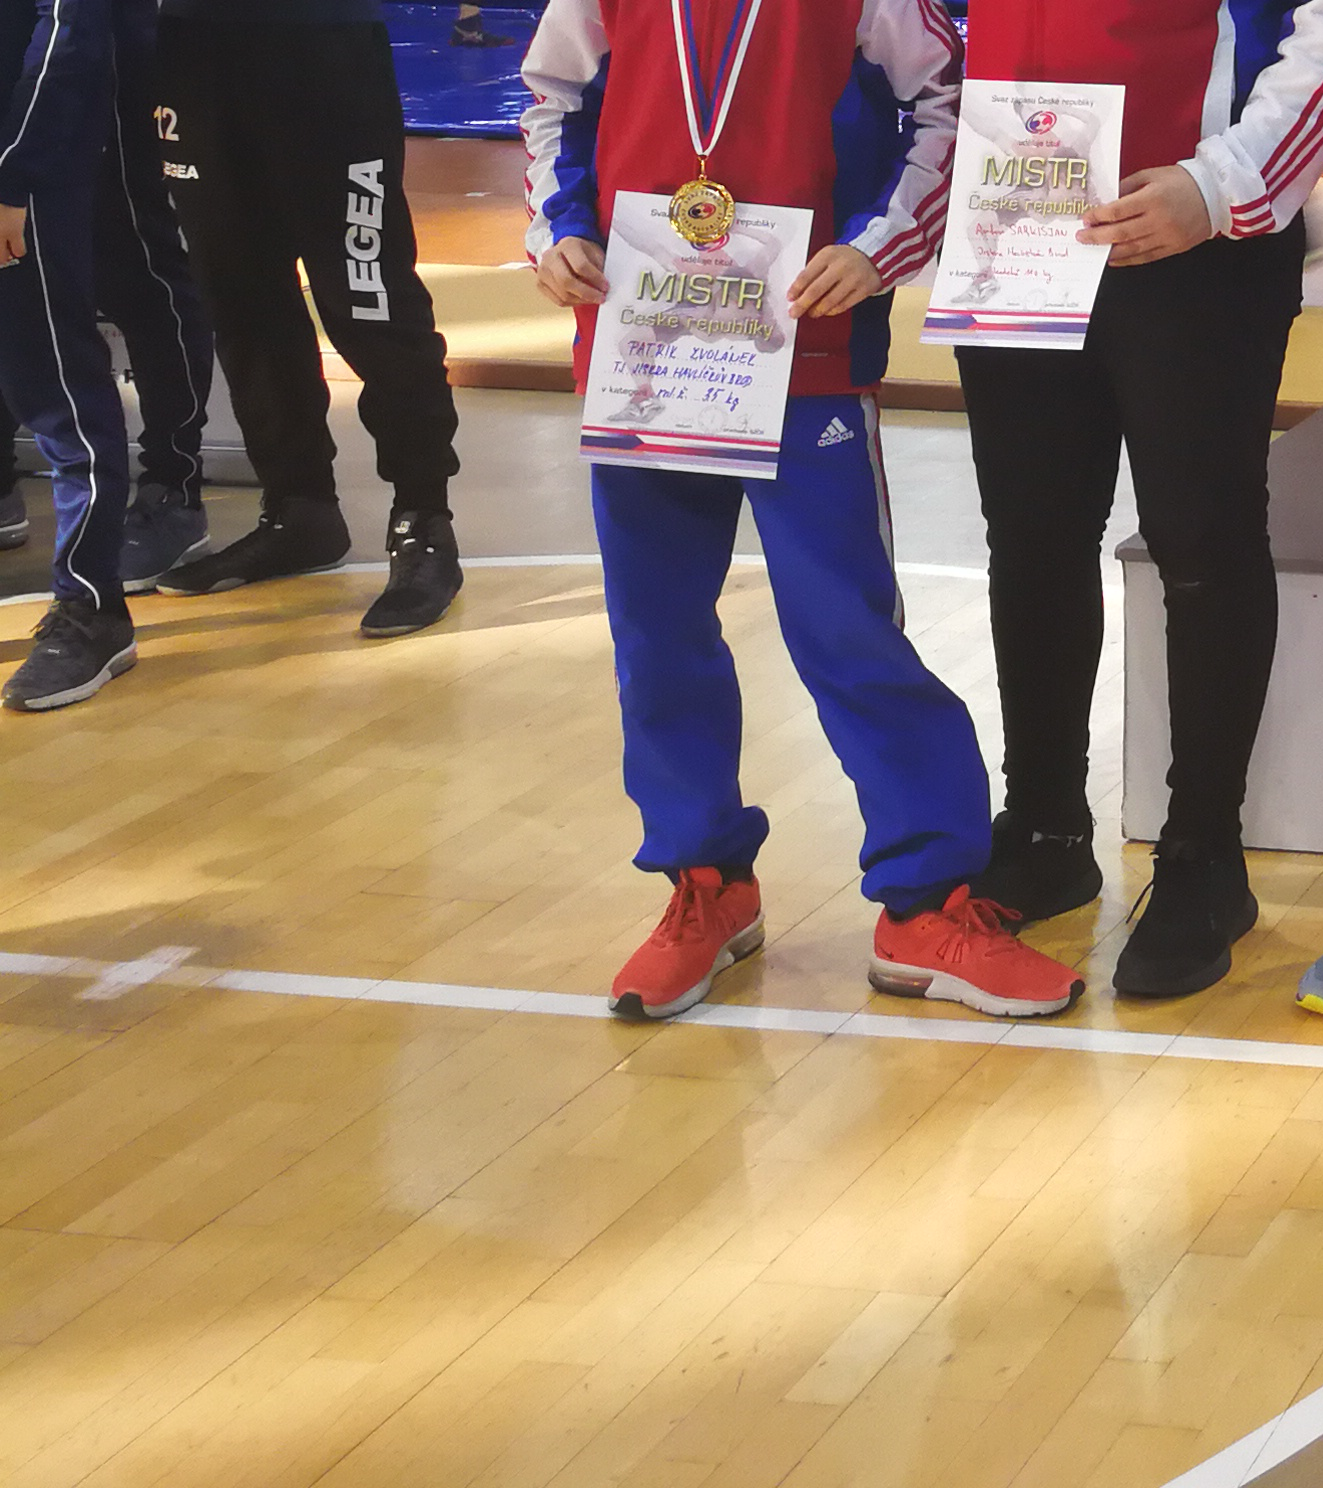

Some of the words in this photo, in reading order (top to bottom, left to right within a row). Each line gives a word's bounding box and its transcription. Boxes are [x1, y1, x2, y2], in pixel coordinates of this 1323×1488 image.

[153, 105, 180, 142] 12
[162, 161, 199, 180] EGEA
[980, 155, 1089, 190] MISTR
[345, 158, 390, 321] LEGEA
[736, 218, 776, 230] republiky
[637, 270, 766, 313] MISTR
[686, 315, 775, 341] republiky
